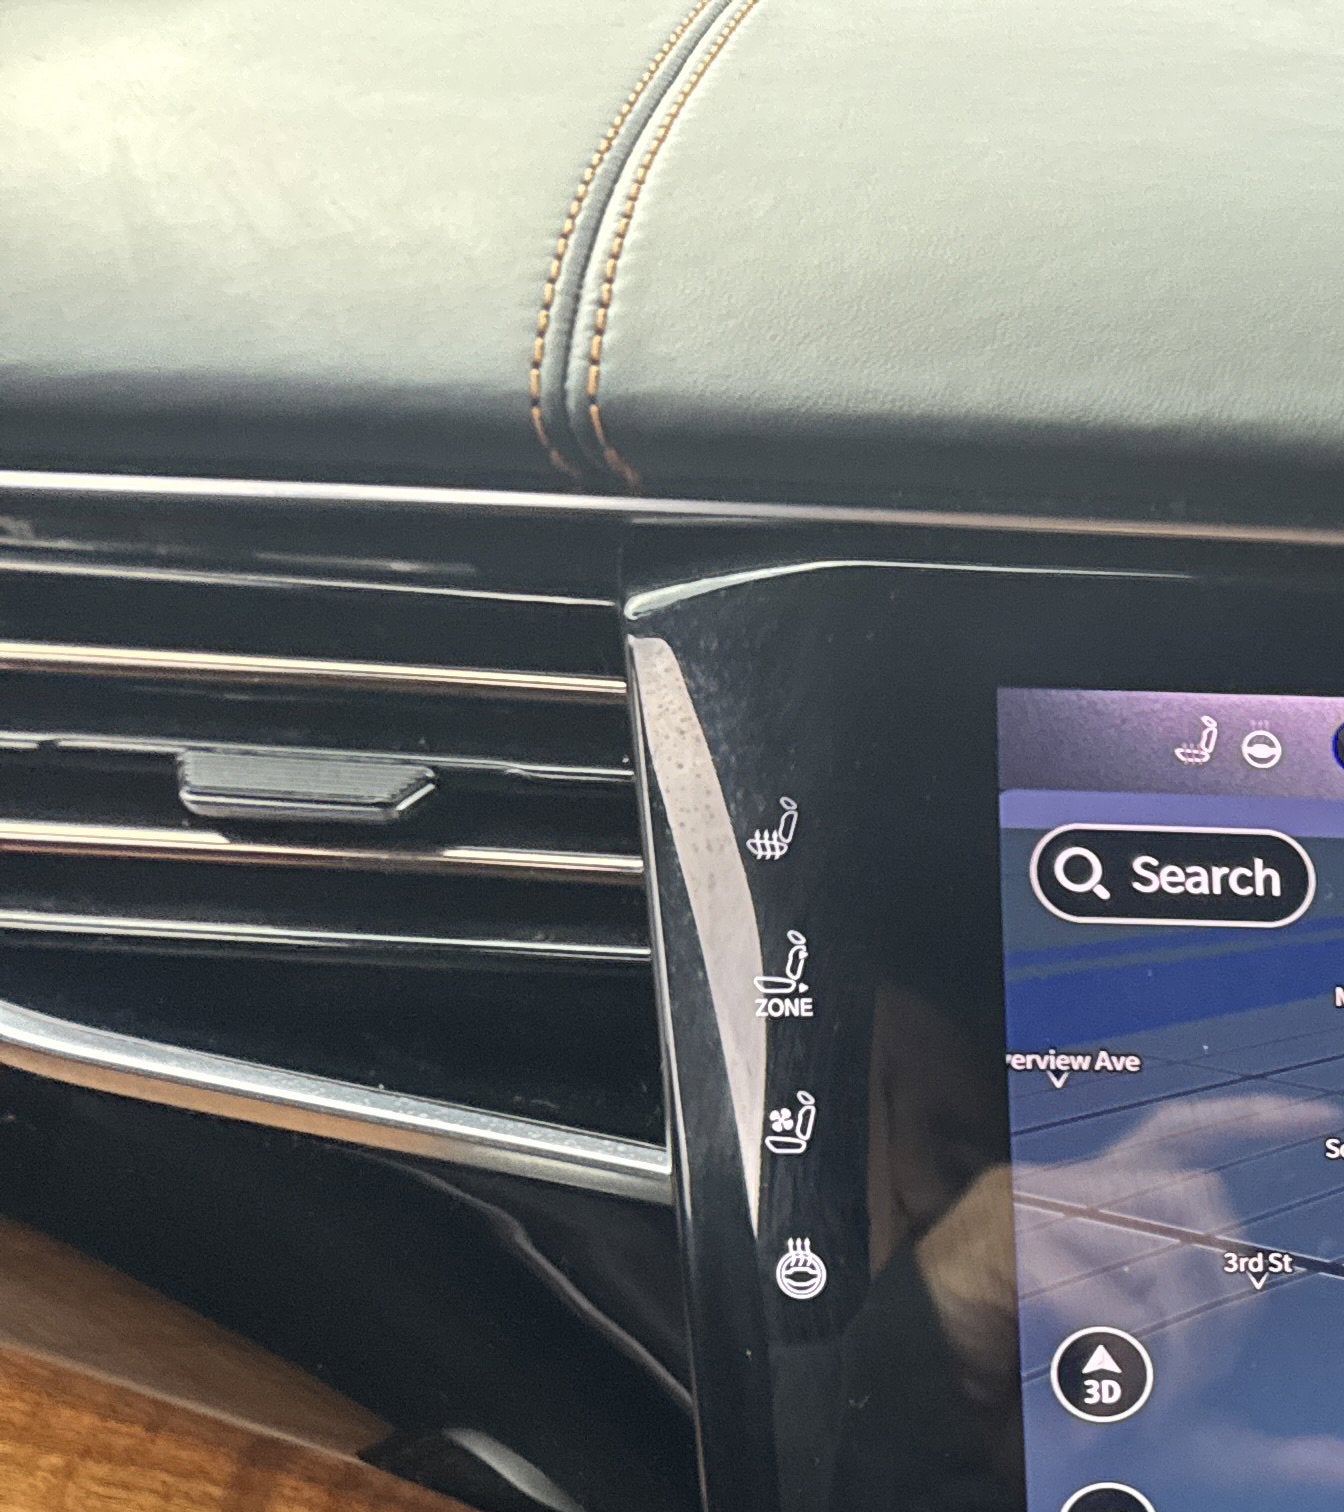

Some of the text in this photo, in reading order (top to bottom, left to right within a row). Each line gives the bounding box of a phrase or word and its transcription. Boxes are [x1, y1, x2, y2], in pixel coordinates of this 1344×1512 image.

[1131, 855, 1281, 897] Search
[755, 998, 814, 1018] ZONE
[1094, 1050, 1141, 1072] Ave
[1223, 1252, 1293, 1273] 3rd St
[1083, 1379, 1122, 1405] 3D
